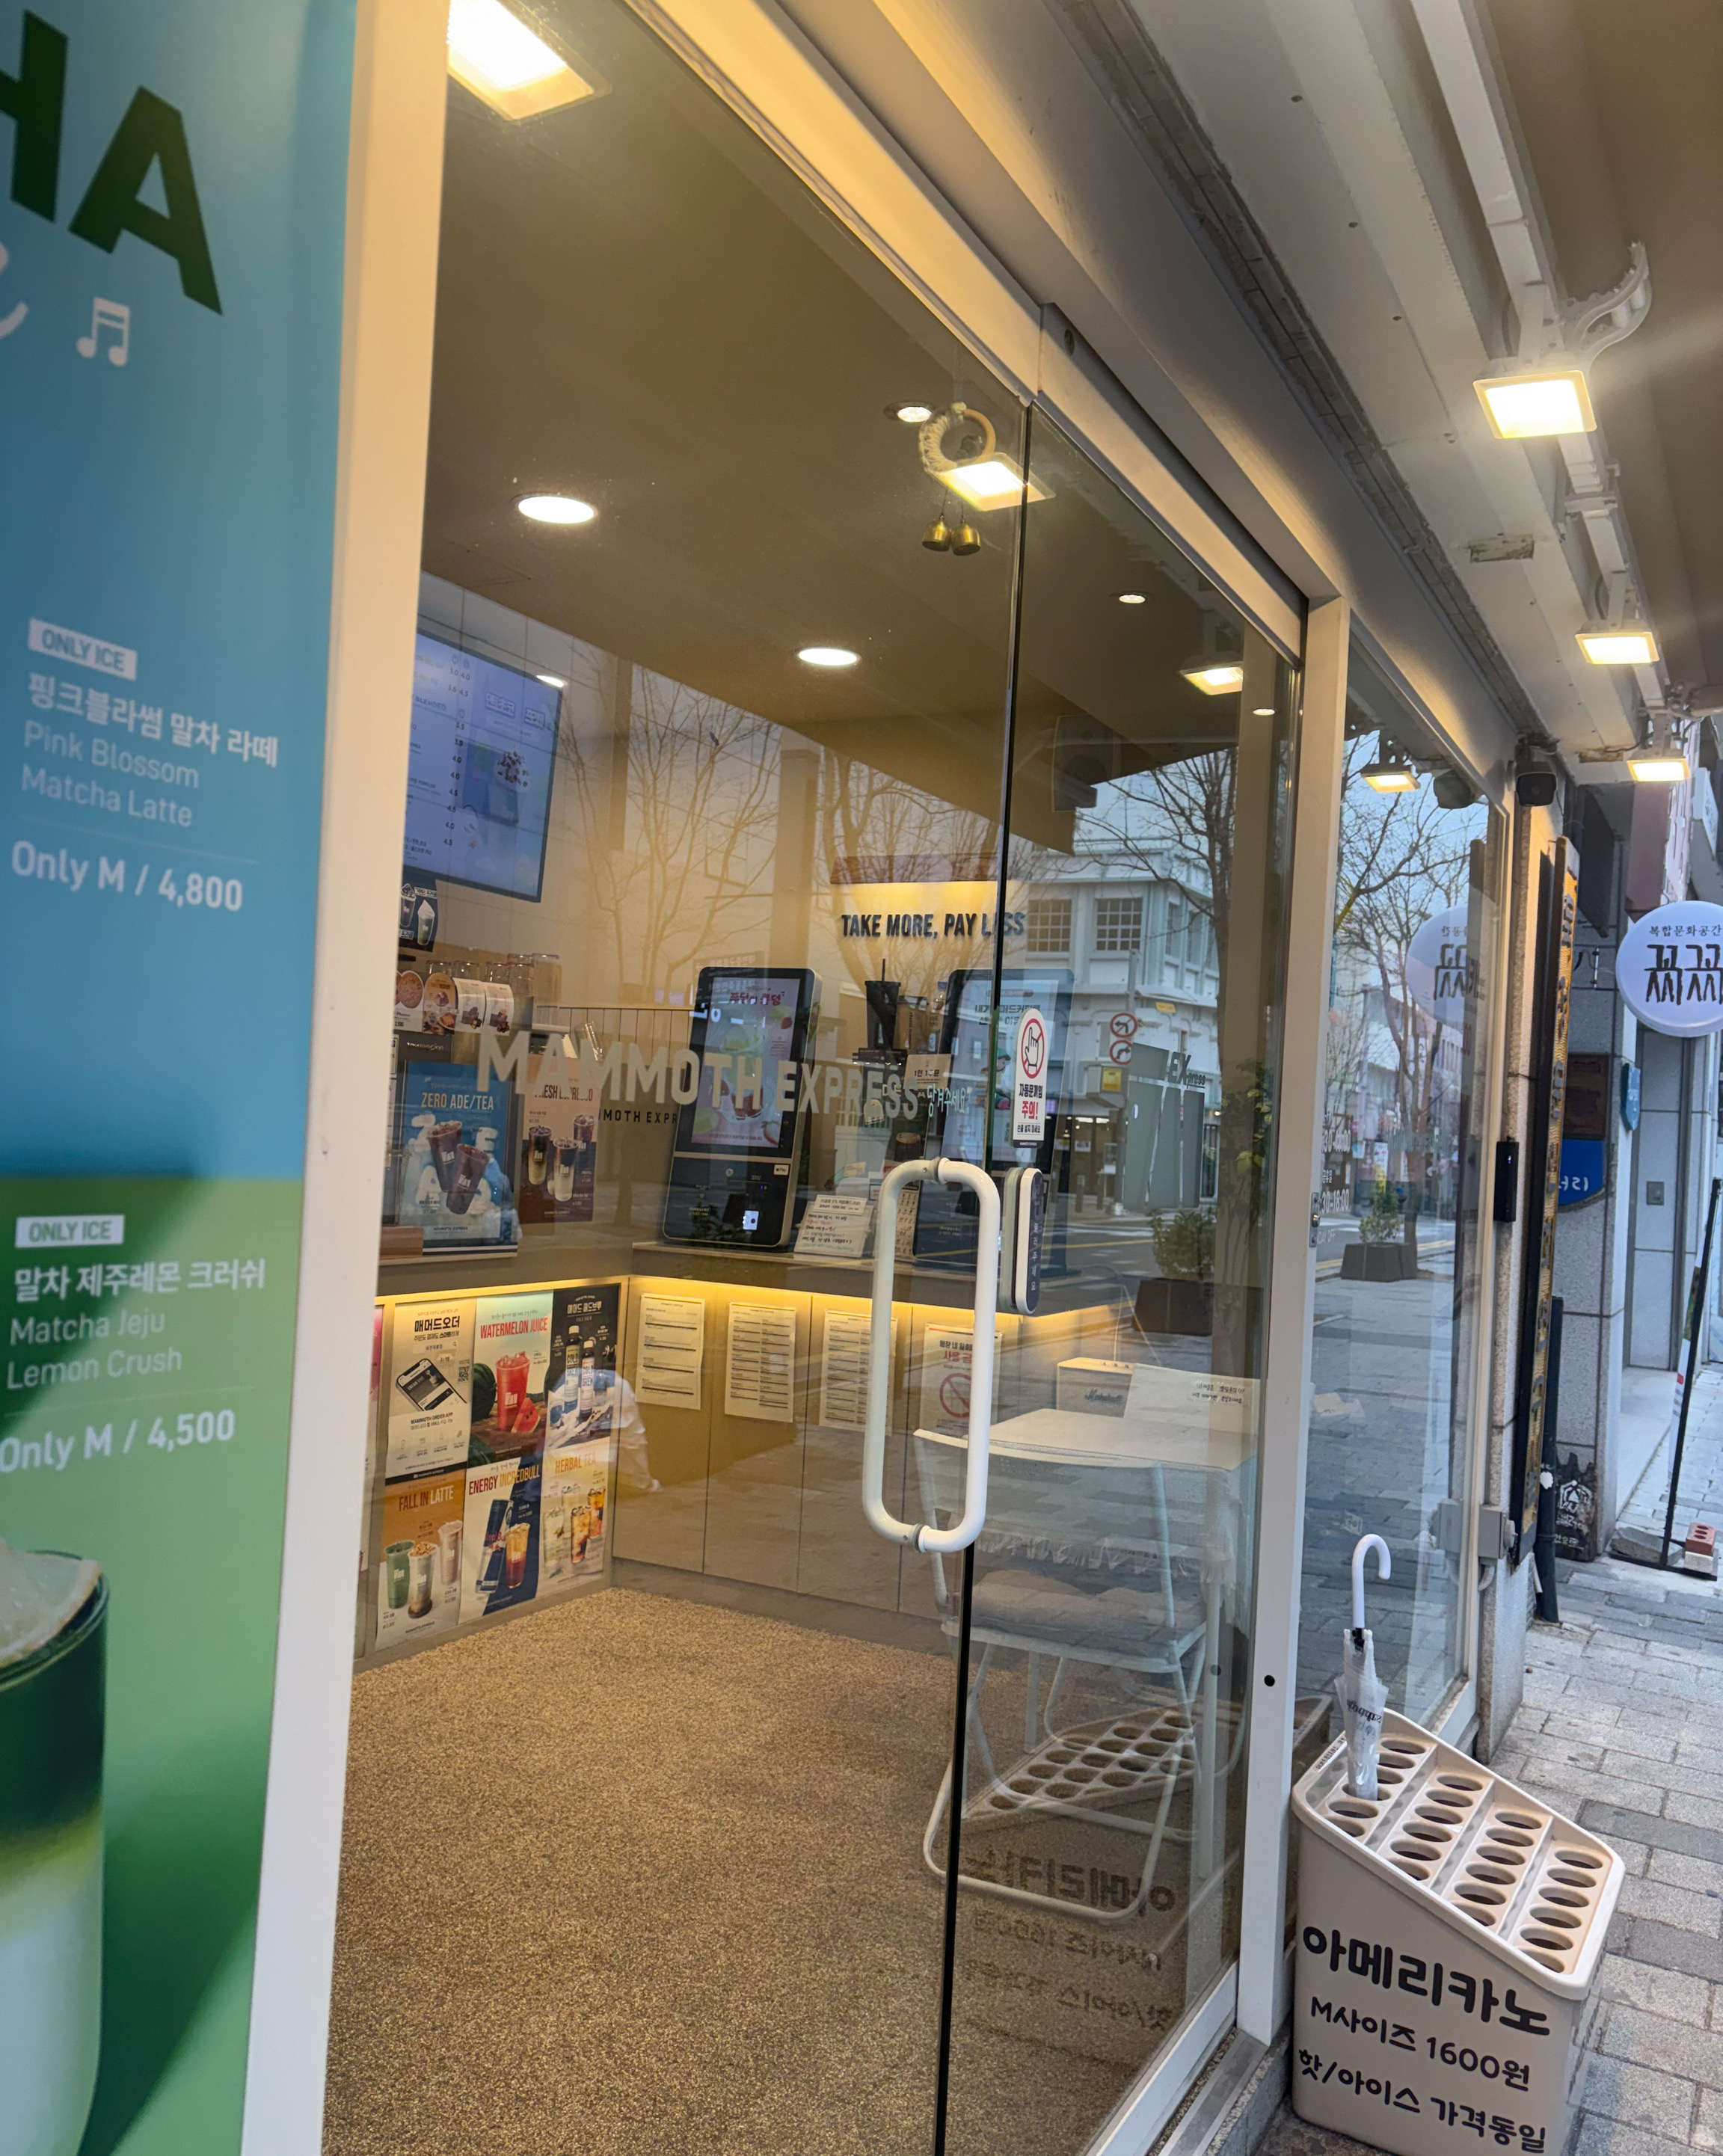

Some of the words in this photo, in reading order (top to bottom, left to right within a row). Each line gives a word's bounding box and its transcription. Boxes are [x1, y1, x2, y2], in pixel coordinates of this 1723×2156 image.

[42, 629, 90, 661] ONLY
[95, 645, 126, 672] ICE
[28, 672, 163, 740] 핑크블라썸
[171, 713, 221, 755] 말차
[227, 730, 279, 768] 라떼
[25, 720, 84, 761] Pink
[91, 738, 200, 788] Blossom
[21, 764, 121, 813] Matcha
[129, 790, 193, 827] Latte
[11, 841, 90, 892] Only
[98, 856, 126, 893] M
[159, 869, 244, 912] 4,800
[841, 914, 882, 938] TAKE
[886, 913, 939, 939] MORE,
[944, 912, 977, 938] PAY
[982, 911, 1027, 937] LSS
[1648, 924, 1723, 938] 복합문화공간
[476, 1029, 763, 1111] MAMMOTH
[775, 1059, 919, 1120] EXPRESS
[421, 1092, 447, 1108] ZERO
[450, 1093, 494, 1111] ADE/TEA
[598, 1108, 641, 1123] MOTH
[1022, 1100, 1039, 1120] 주의!
[28, 1223, 79, 1243] ONLY
[82, 1220, 112, 1241] ICE
[15, 1265, 71, 1303] 말차
[76, 1260, 181, 1297] 제주레몬
[187, 1258, 266, 1291] 크러쉬
[10, 1312, 110, 1346] Matcha
[117, 1309, 167, 1339] Jeju
[414, 1315, 461, 1332] 매머드오더
[480, 1319, 529, 1339] WATERMELON
[530, 1317, 548, 1333] JUICE
[7, 1356, 99, 1389] Lemon
[108, 1346, 182, 1378] Crush
[943, 1351, 960, 1363] 사용
[962, 1353, 973, 1364] 금
[0, 1431, 74, 1473] Only
[83, 1424, 113, 1459] M
[147, 1410, 236, 1453] 4,500
[469, 1475, 499, 1495] ENERGY
[500, 1464, 541, 1487] INCREDBULL
[555, 1455, 583, 1475] HERBAL
[399, 1493, 419, 1512] FALL
[420, 1490, 429, 1507] IN
[430, 1484, 455, 1505] LATTE
[1302, 1925, 1550, 2036] 아메리카노
[1311, 1996, 1417, 2052] M사이즈
[1426, 2036, 1532, 2092] 1600원
[1298, 2048, 1420, 2113] 핫/아이스
[1430, 2096, 1547, 2155] 가격동일
